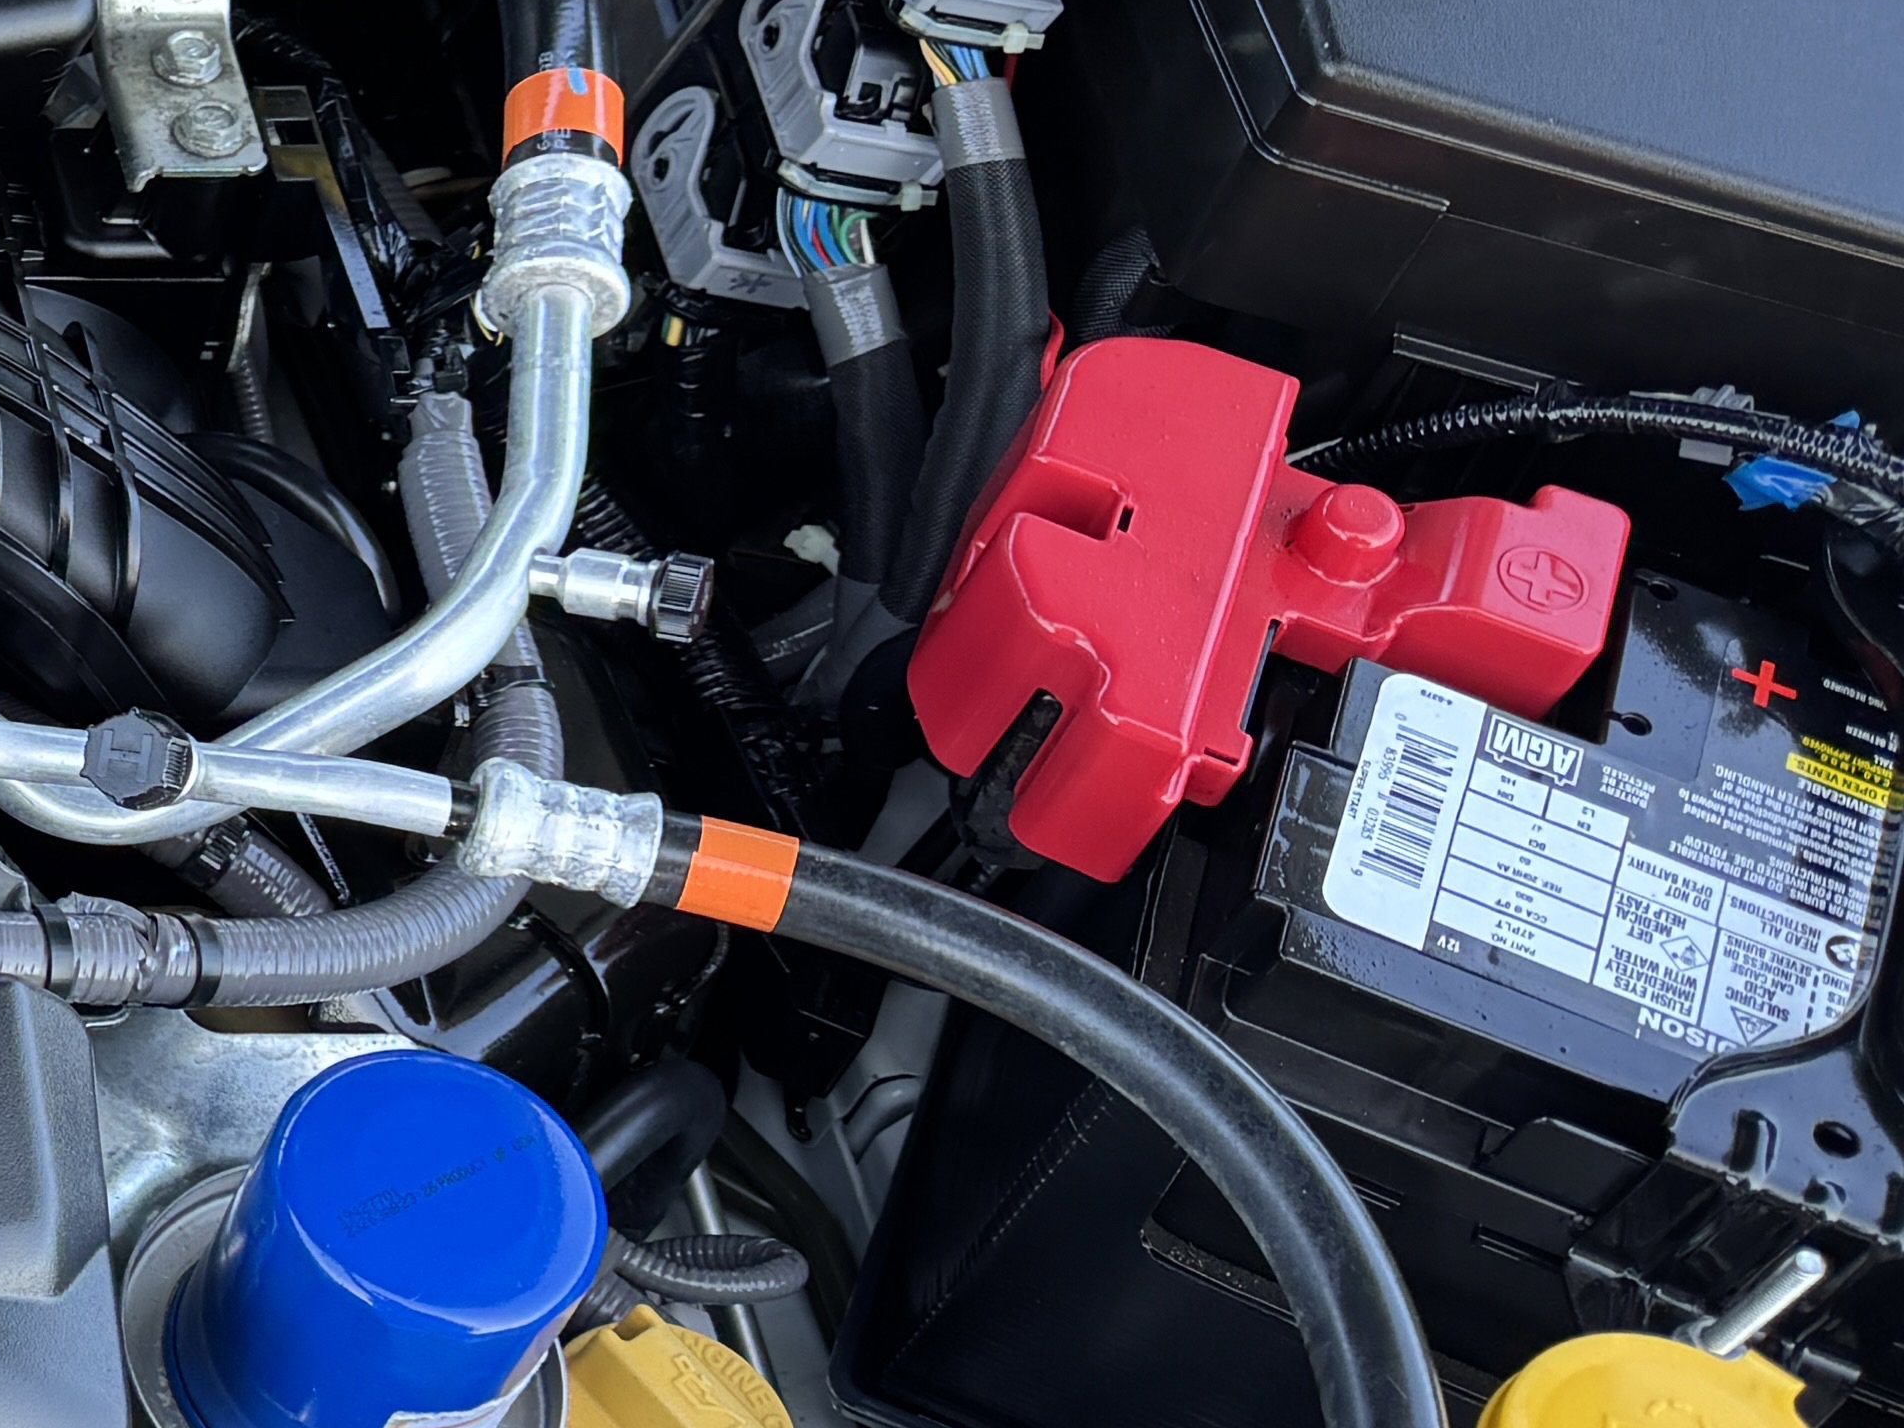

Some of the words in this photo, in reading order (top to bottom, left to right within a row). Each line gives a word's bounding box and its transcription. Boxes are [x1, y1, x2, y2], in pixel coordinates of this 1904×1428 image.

[96, 727, 154, 784] H
[1488, 720, 1578, 777] AGM
[1707, 761, 1777, 796] HANDLING.
[1789, 755, 1840, 785] VENTS.
[1598, 782, 1649, 809] BATTERY
[1616, 780, 1650, 800] MUST
[1675, 785, 1691, 801] to
[1720, 778, 1734, 792] of
[1732, 784, 1764, 804] State
[1839, 777, 1879, 800] OPEN
[1345, 788, 1364, 819] START
[1689, 791, 1728, 815] known
[1762, 796, 1783, 812] the
[1775, 787, 1815, 812] AFTER
[1793, 776, 1886, 820] SERVICEABLE
[1681, 801, 1723, 825] related
[1721, 817, 1744, 834] and
[1725, 807, 1783, 837] chemicals
[1740, 799, 1810, 834] reproductive
[1791, 807, 1833, 832] known
[1813, 803, 1858, 830] HANDS
[1681, 833, 1729, 859] FOLLOW
[1742, 825, 1799, 855] terminals
[1808, 826, 1832, 844] and
[1831, 835, 1870, 858] cancer
[1623, 852, 1680, 884] BATTERY.
[1665, 838, 1744, 877] DISASSEMBLE
[1762, 852, 1848, 893] INSTRUCTIONS.
[1765, 877, 1785, 893] DO
[1664, 883, 1691, 903] NOT
[1677, 875, 1714, 898] OPEN
[1611, 889, 1651, 915] FAST.
[1691, 893, 1712, 911] DO
[1493, 917, 1536, 941] 47PLT
[1611, 903, 1674, 938] MEDICAL
[1650, 905, 1688, 930] HELP
[1722, 893, 1824, 941] INSTRUCTIONS.
[1756, 919, 1782, 939] ALL
[1435, 932, 1463, 954] 12V
[1625, 923, 1655, 945] GET
[1782, 929, 1820, 954] READ
[1508, 939, 1537, 956] PART
[1606, 943, 1661, 975] WATER.
[1721, 945, 1740, 961] OR
[1728, 961, 1769, 984] CAUSE
[1739, 953, 1809, 988] BLINDNESS
[1766, 949, 1814, 977] SEVERE
[1602, 957, 1697, 1003] IMMEDIATELY
[1611, 974, 1648, 998] EYES
[1660, 965, 1699, 990] WITH
[1741, 978, 1777, 1002] ACID
[1768, 976, 1796, 996] CAN
[1647, 988, 1694, 1017] FLUSH
[1721, 984, 1792, 1022] SULFURIC
